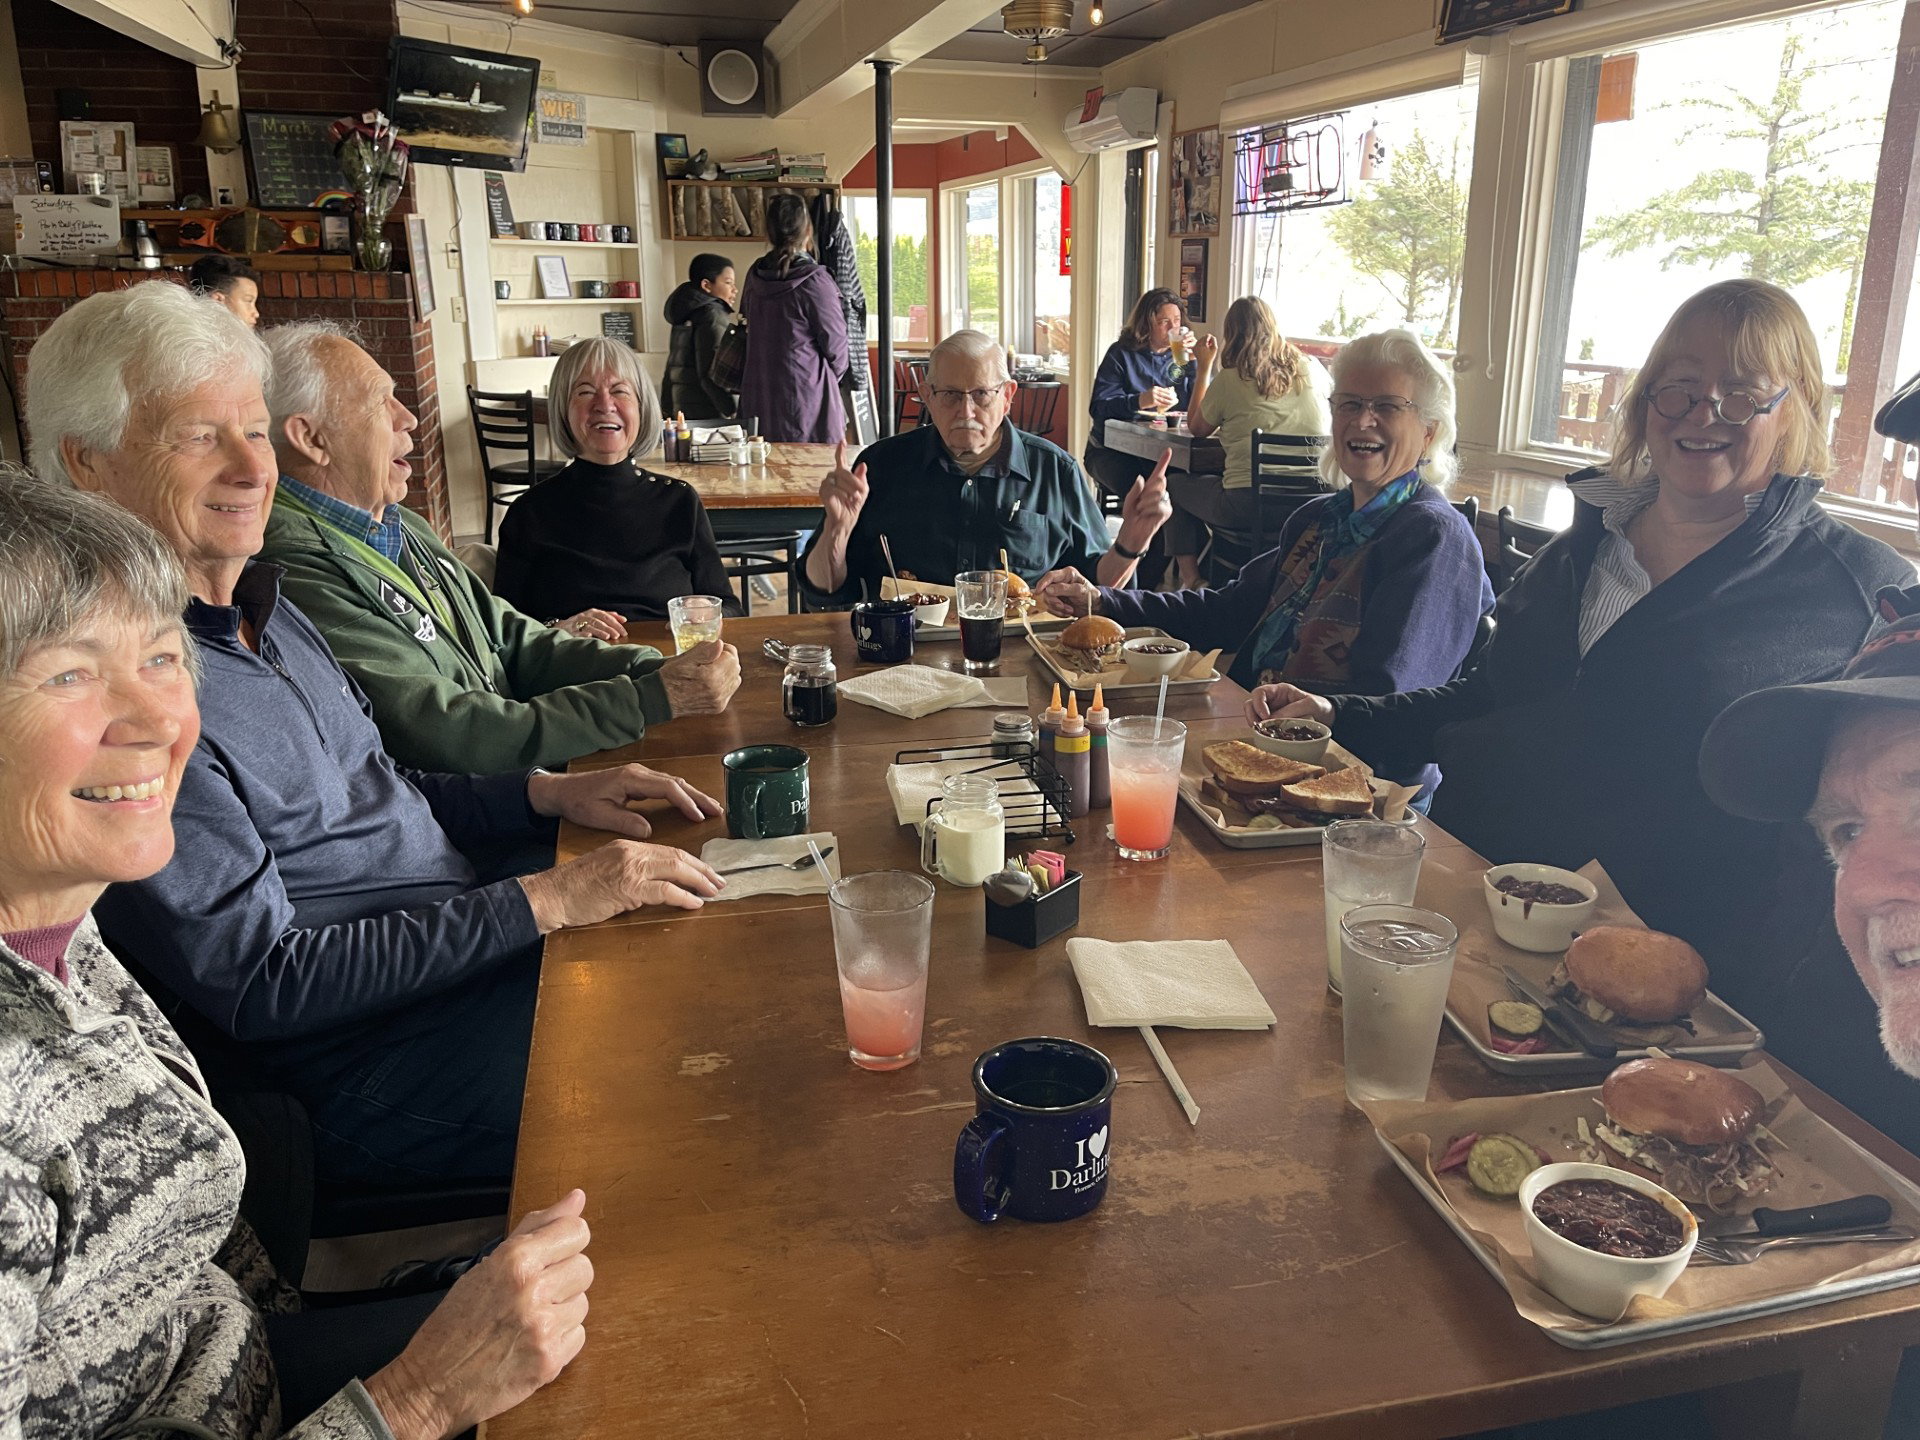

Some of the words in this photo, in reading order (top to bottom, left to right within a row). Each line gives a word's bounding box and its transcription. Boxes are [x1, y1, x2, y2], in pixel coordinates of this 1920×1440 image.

[541, 98, 577, 119] WIFI
[262, 117, 314, 134] March
[1074, 1138, 1088, 1169] I
[1049, 1154, 1109, 1191] Darlin
